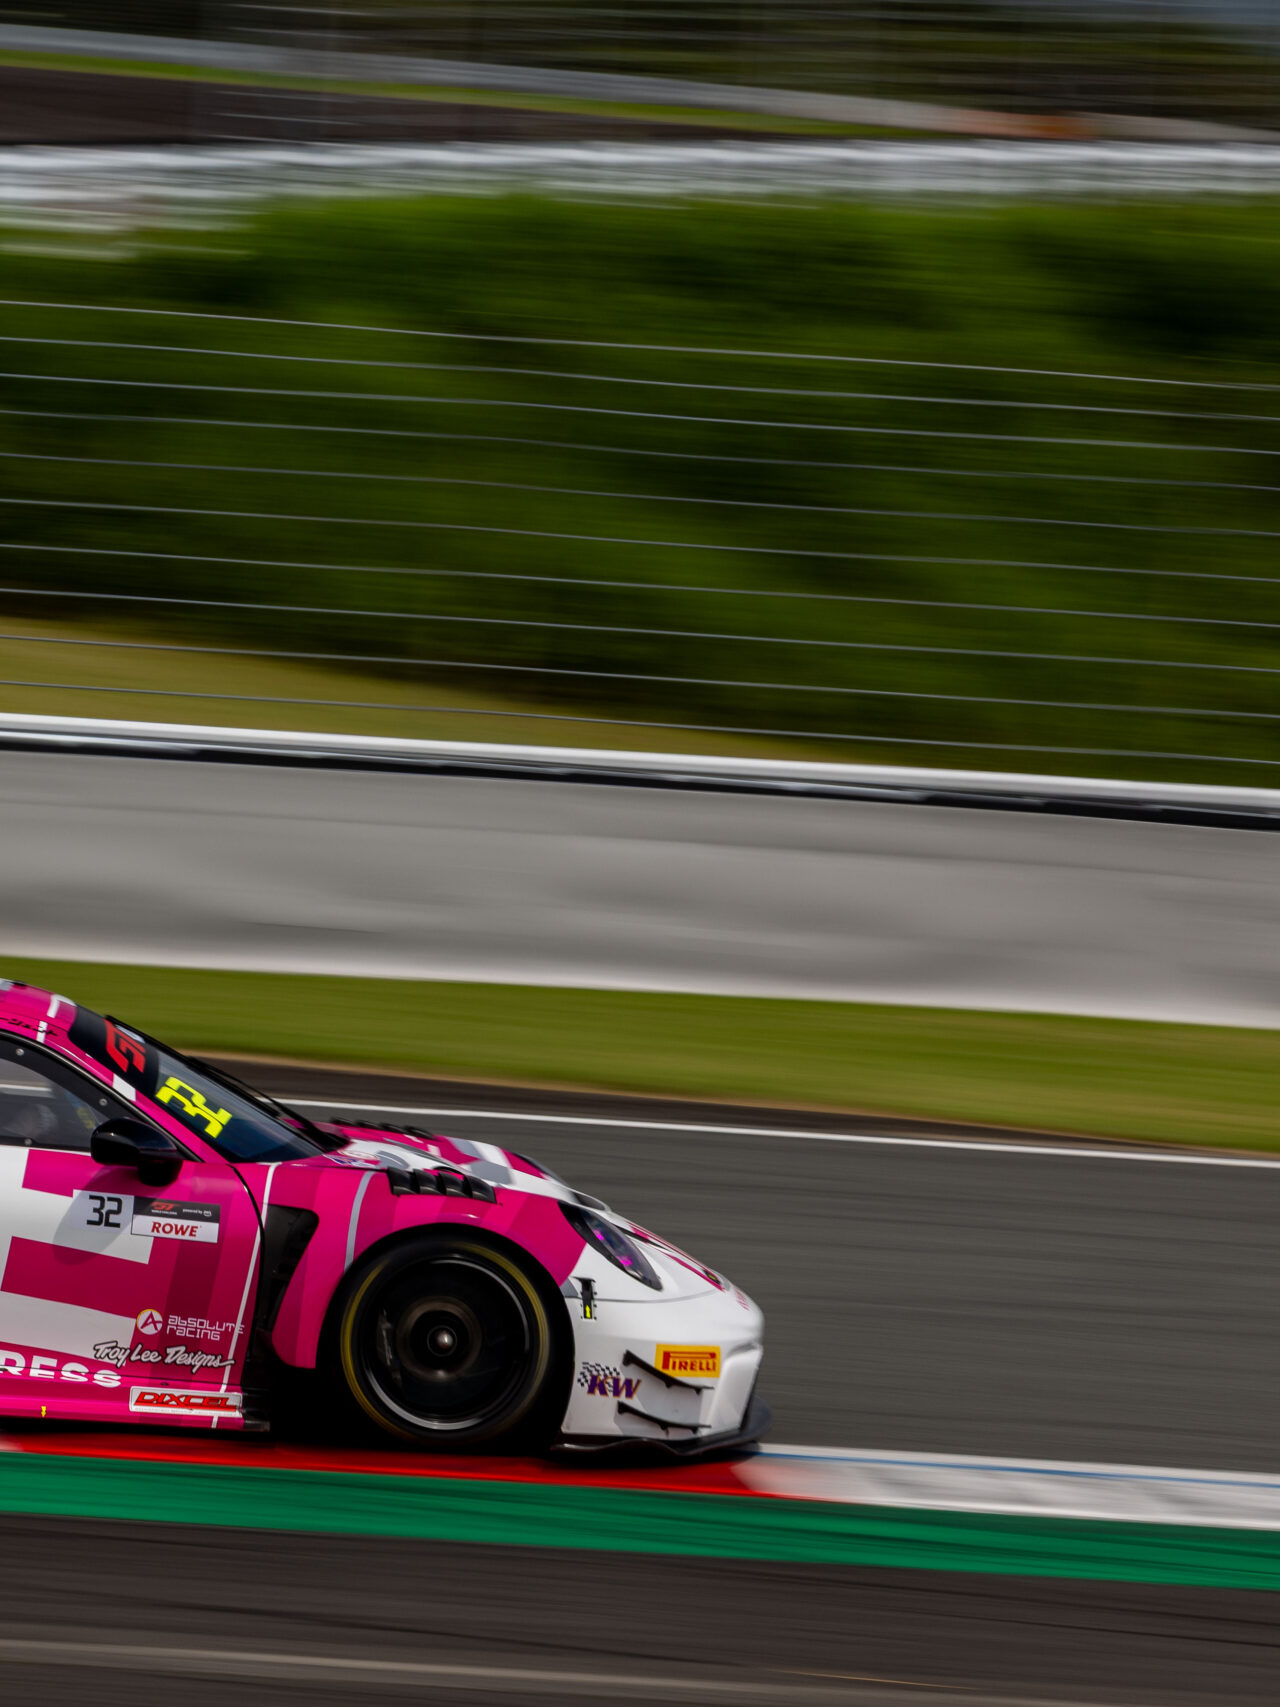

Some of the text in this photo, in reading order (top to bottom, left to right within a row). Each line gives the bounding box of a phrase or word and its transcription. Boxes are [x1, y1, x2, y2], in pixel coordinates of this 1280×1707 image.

[86, 1194, 123, 1228] 32
[151, 1221, 199, 1238] ROWE
[93, 1340, 236, 1374] Troy Lee Designs
[661, 1351, 717, 1372] PIRELLI
[587, 1374, 642, 1399] KW
[134, 1391, 233, 1411] DIXCEL
